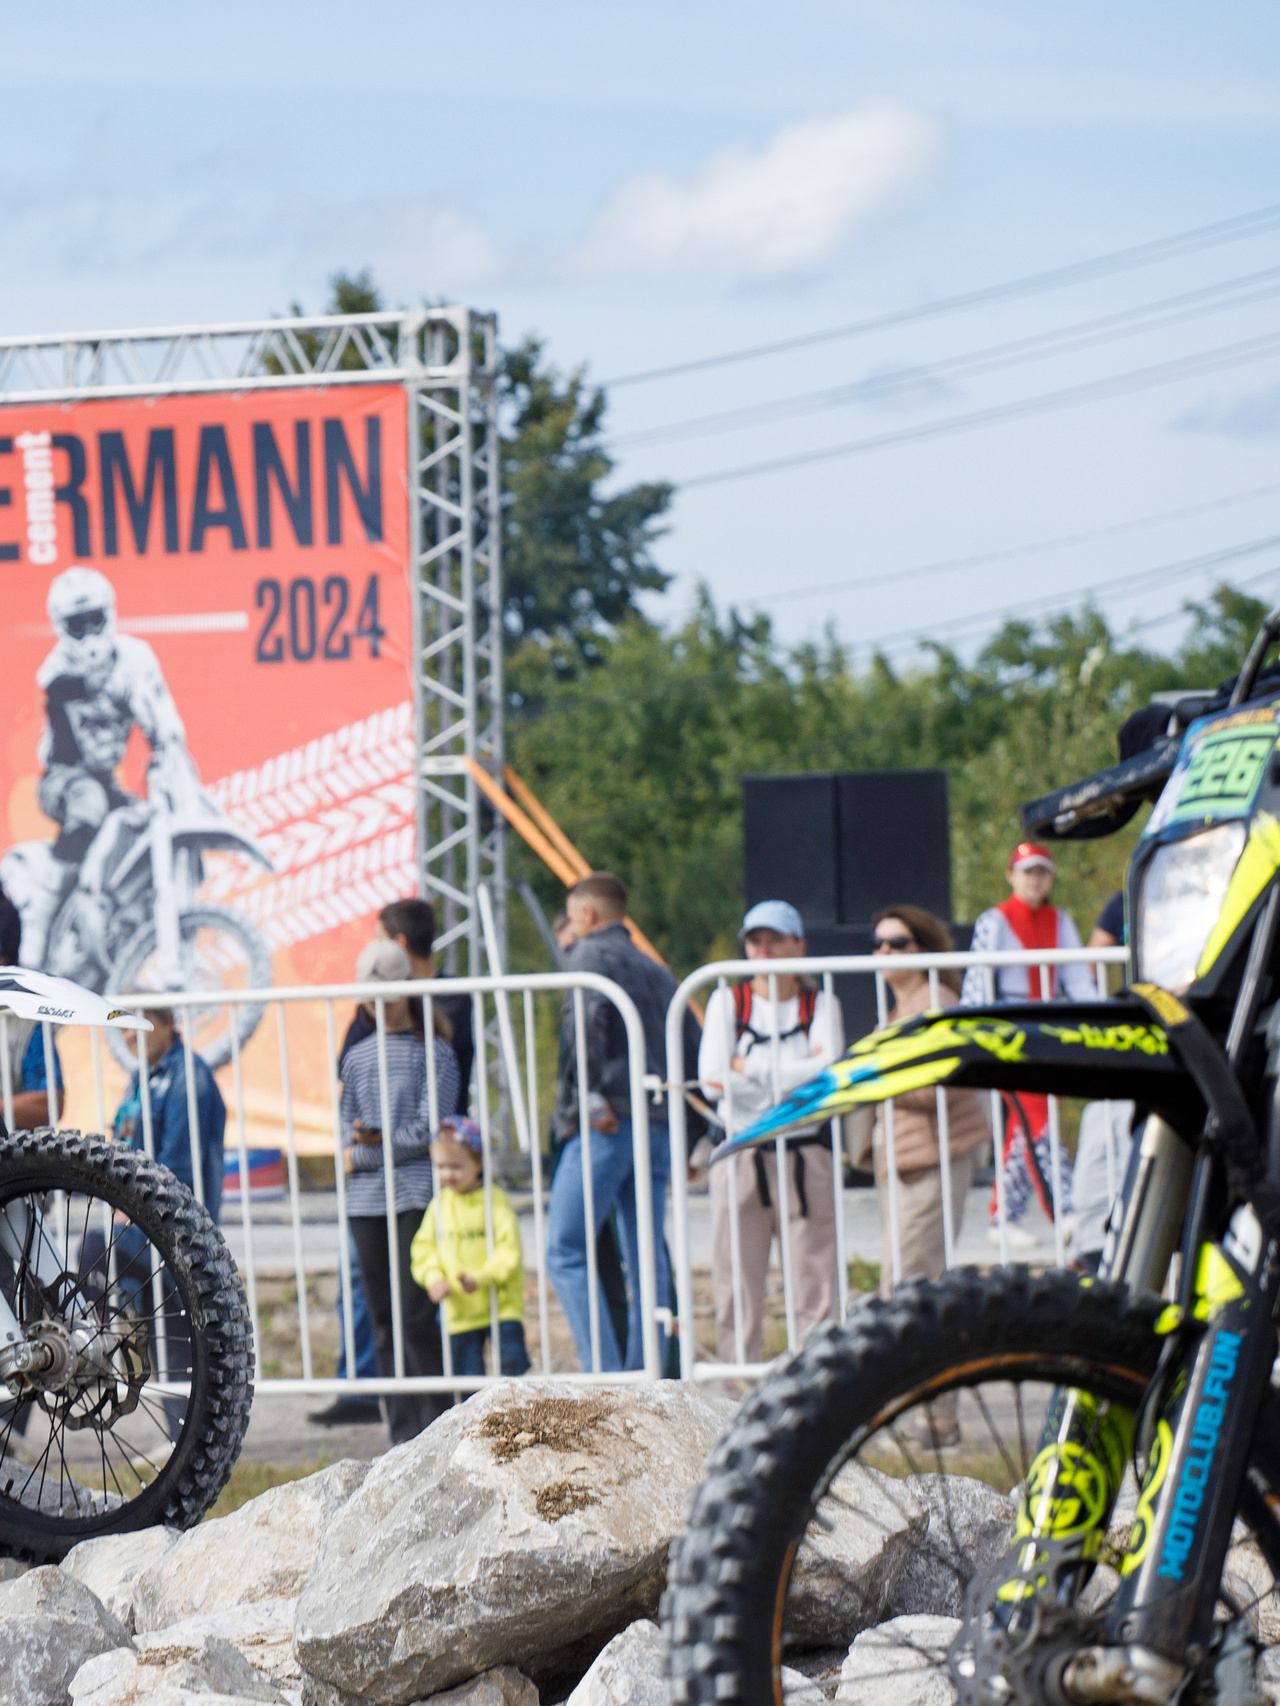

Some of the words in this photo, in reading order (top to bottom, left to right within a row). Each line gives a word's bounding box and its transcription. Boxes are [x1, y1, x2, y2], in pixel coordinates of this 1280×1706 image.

[14, 430, 58, 565] cement
[254, 574, 386, 664] 2024
[1178, 738, 1272, 804] 226
[1158, 1330, 1242, 1581] MOTOCLUB.FUN
